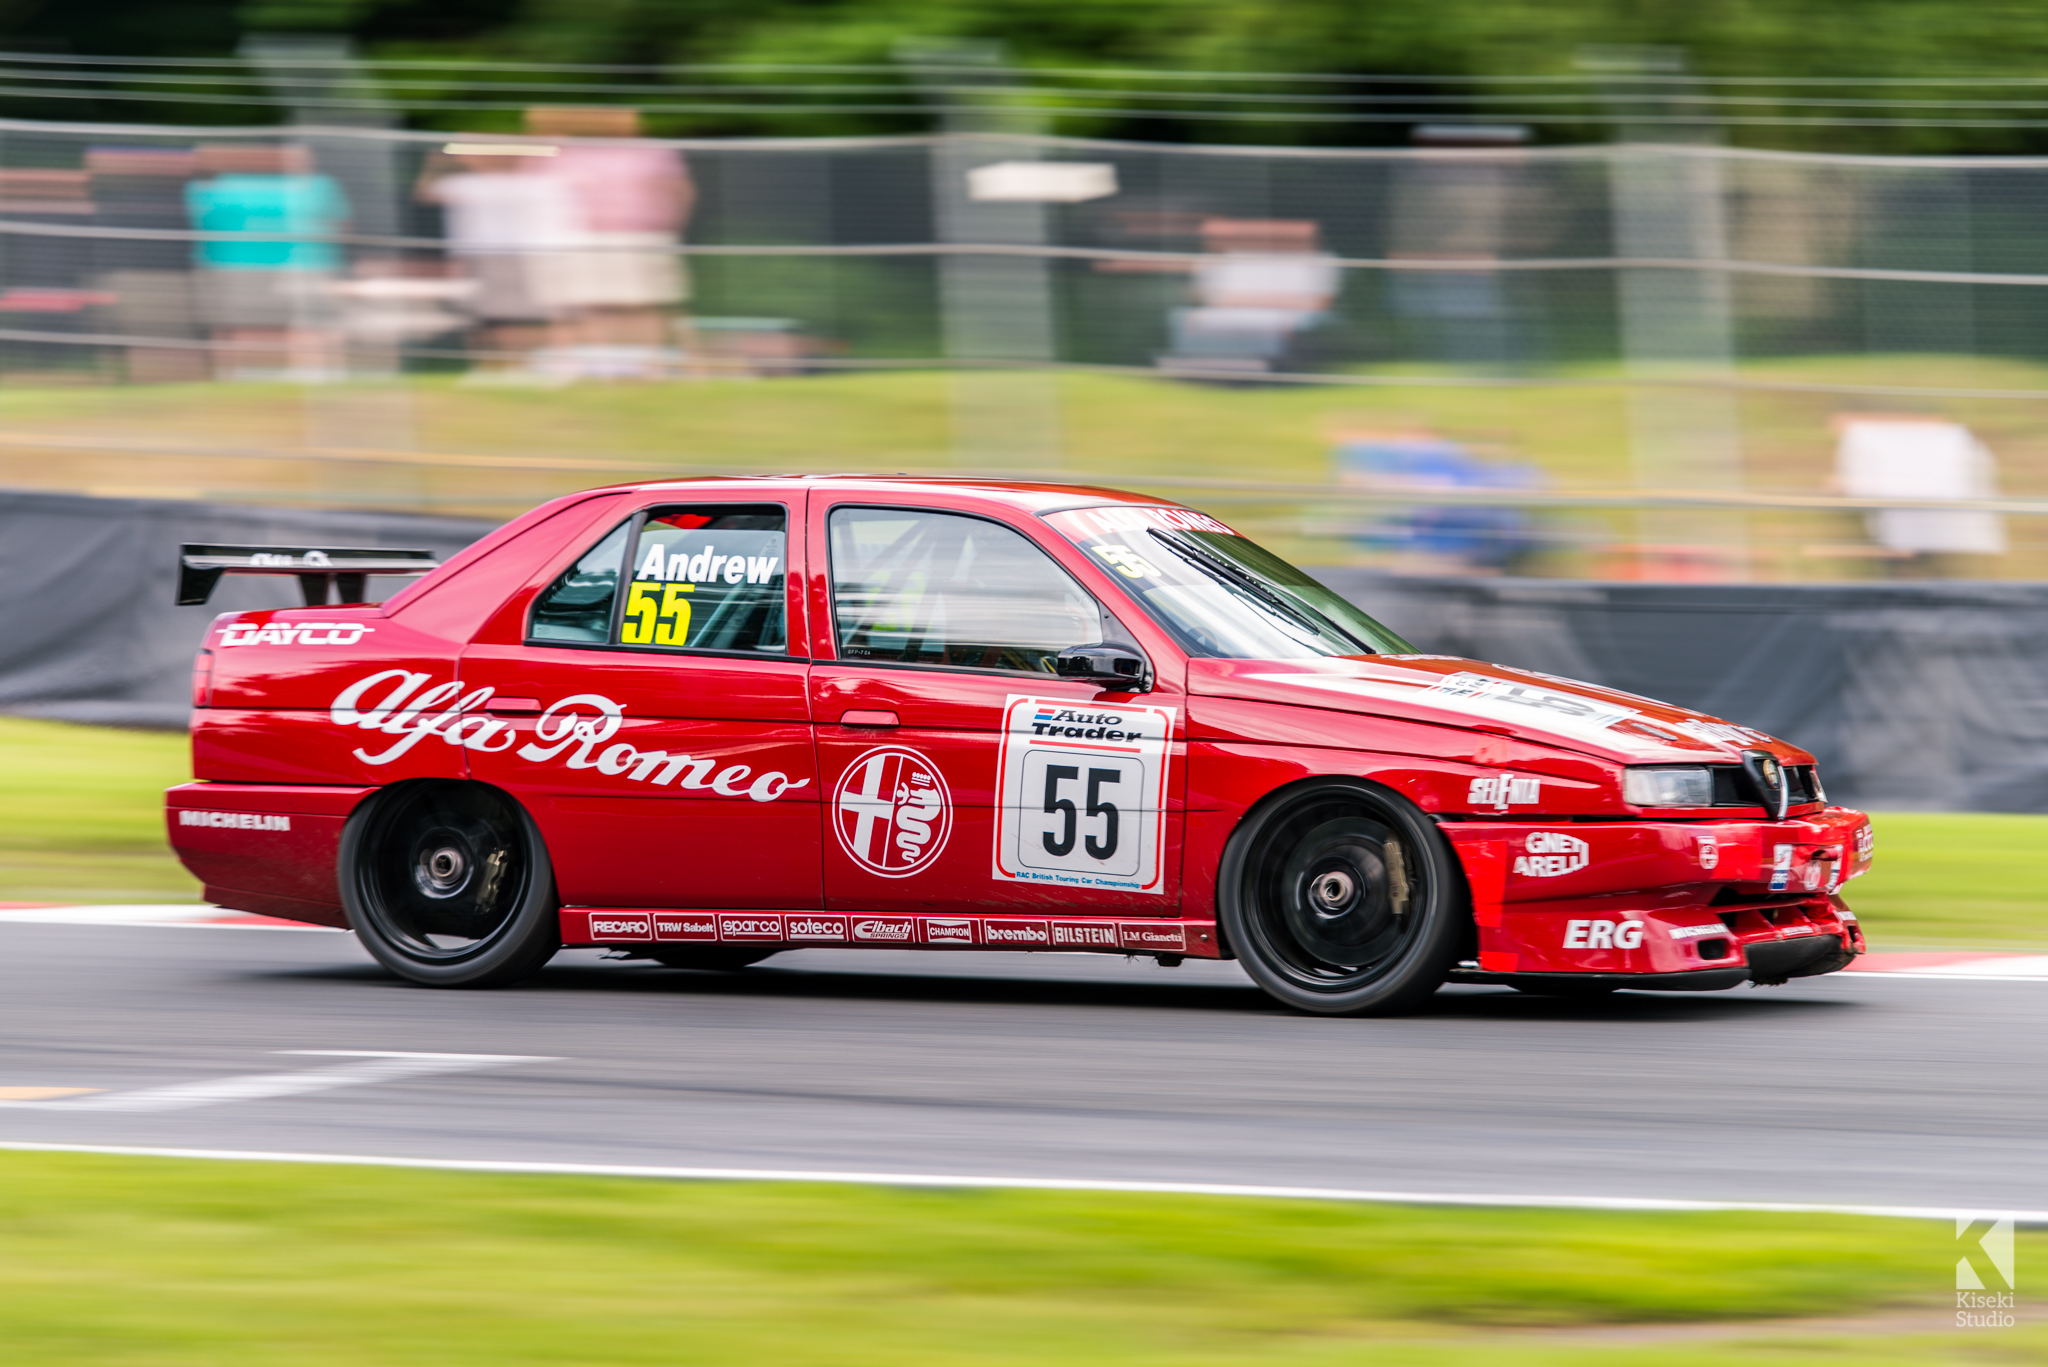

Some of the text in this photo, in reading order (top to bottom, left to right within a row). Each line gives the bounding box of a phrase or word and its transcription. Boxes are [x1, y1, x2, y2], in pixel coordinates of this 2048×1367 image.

[636, 543, 779, 585] Andrew
[621, 581, 696, 646] 55
[216, 622, 375, 648] DAYCO
[1052, 709, 1123, 725] Auto
[330, 668, 811, 803] Alfa Romeo
[1031, 722, 1143, 743] Trader
[179, 810, 291, 831] MICHELIN
[1042, 764, 1122, 861] 55
[1016, 871, 1030, 879] RAC
[1032, 872, 1054, 881] British
[1055, 874, 1079, 884] Touring
[1095, 878, 1140, 889] Championship
[592, 920, 648, 934] RECARO
[657, 921, 714, 933] TRW Sabelt
[722, 919, 779, 937] sparco
[790, 918, 844, 934] soteco
[854, 920, 912, 939] Eibach
[929, 926, 970, 938] CHAMPION
[987, 925, 1047, 942] brembo
[1055, 926, 1114, 944] BILSTEIN
[1562, 919, 1645, 949] ERG
[1123, 931, 1182, 942] LM Gianetti
